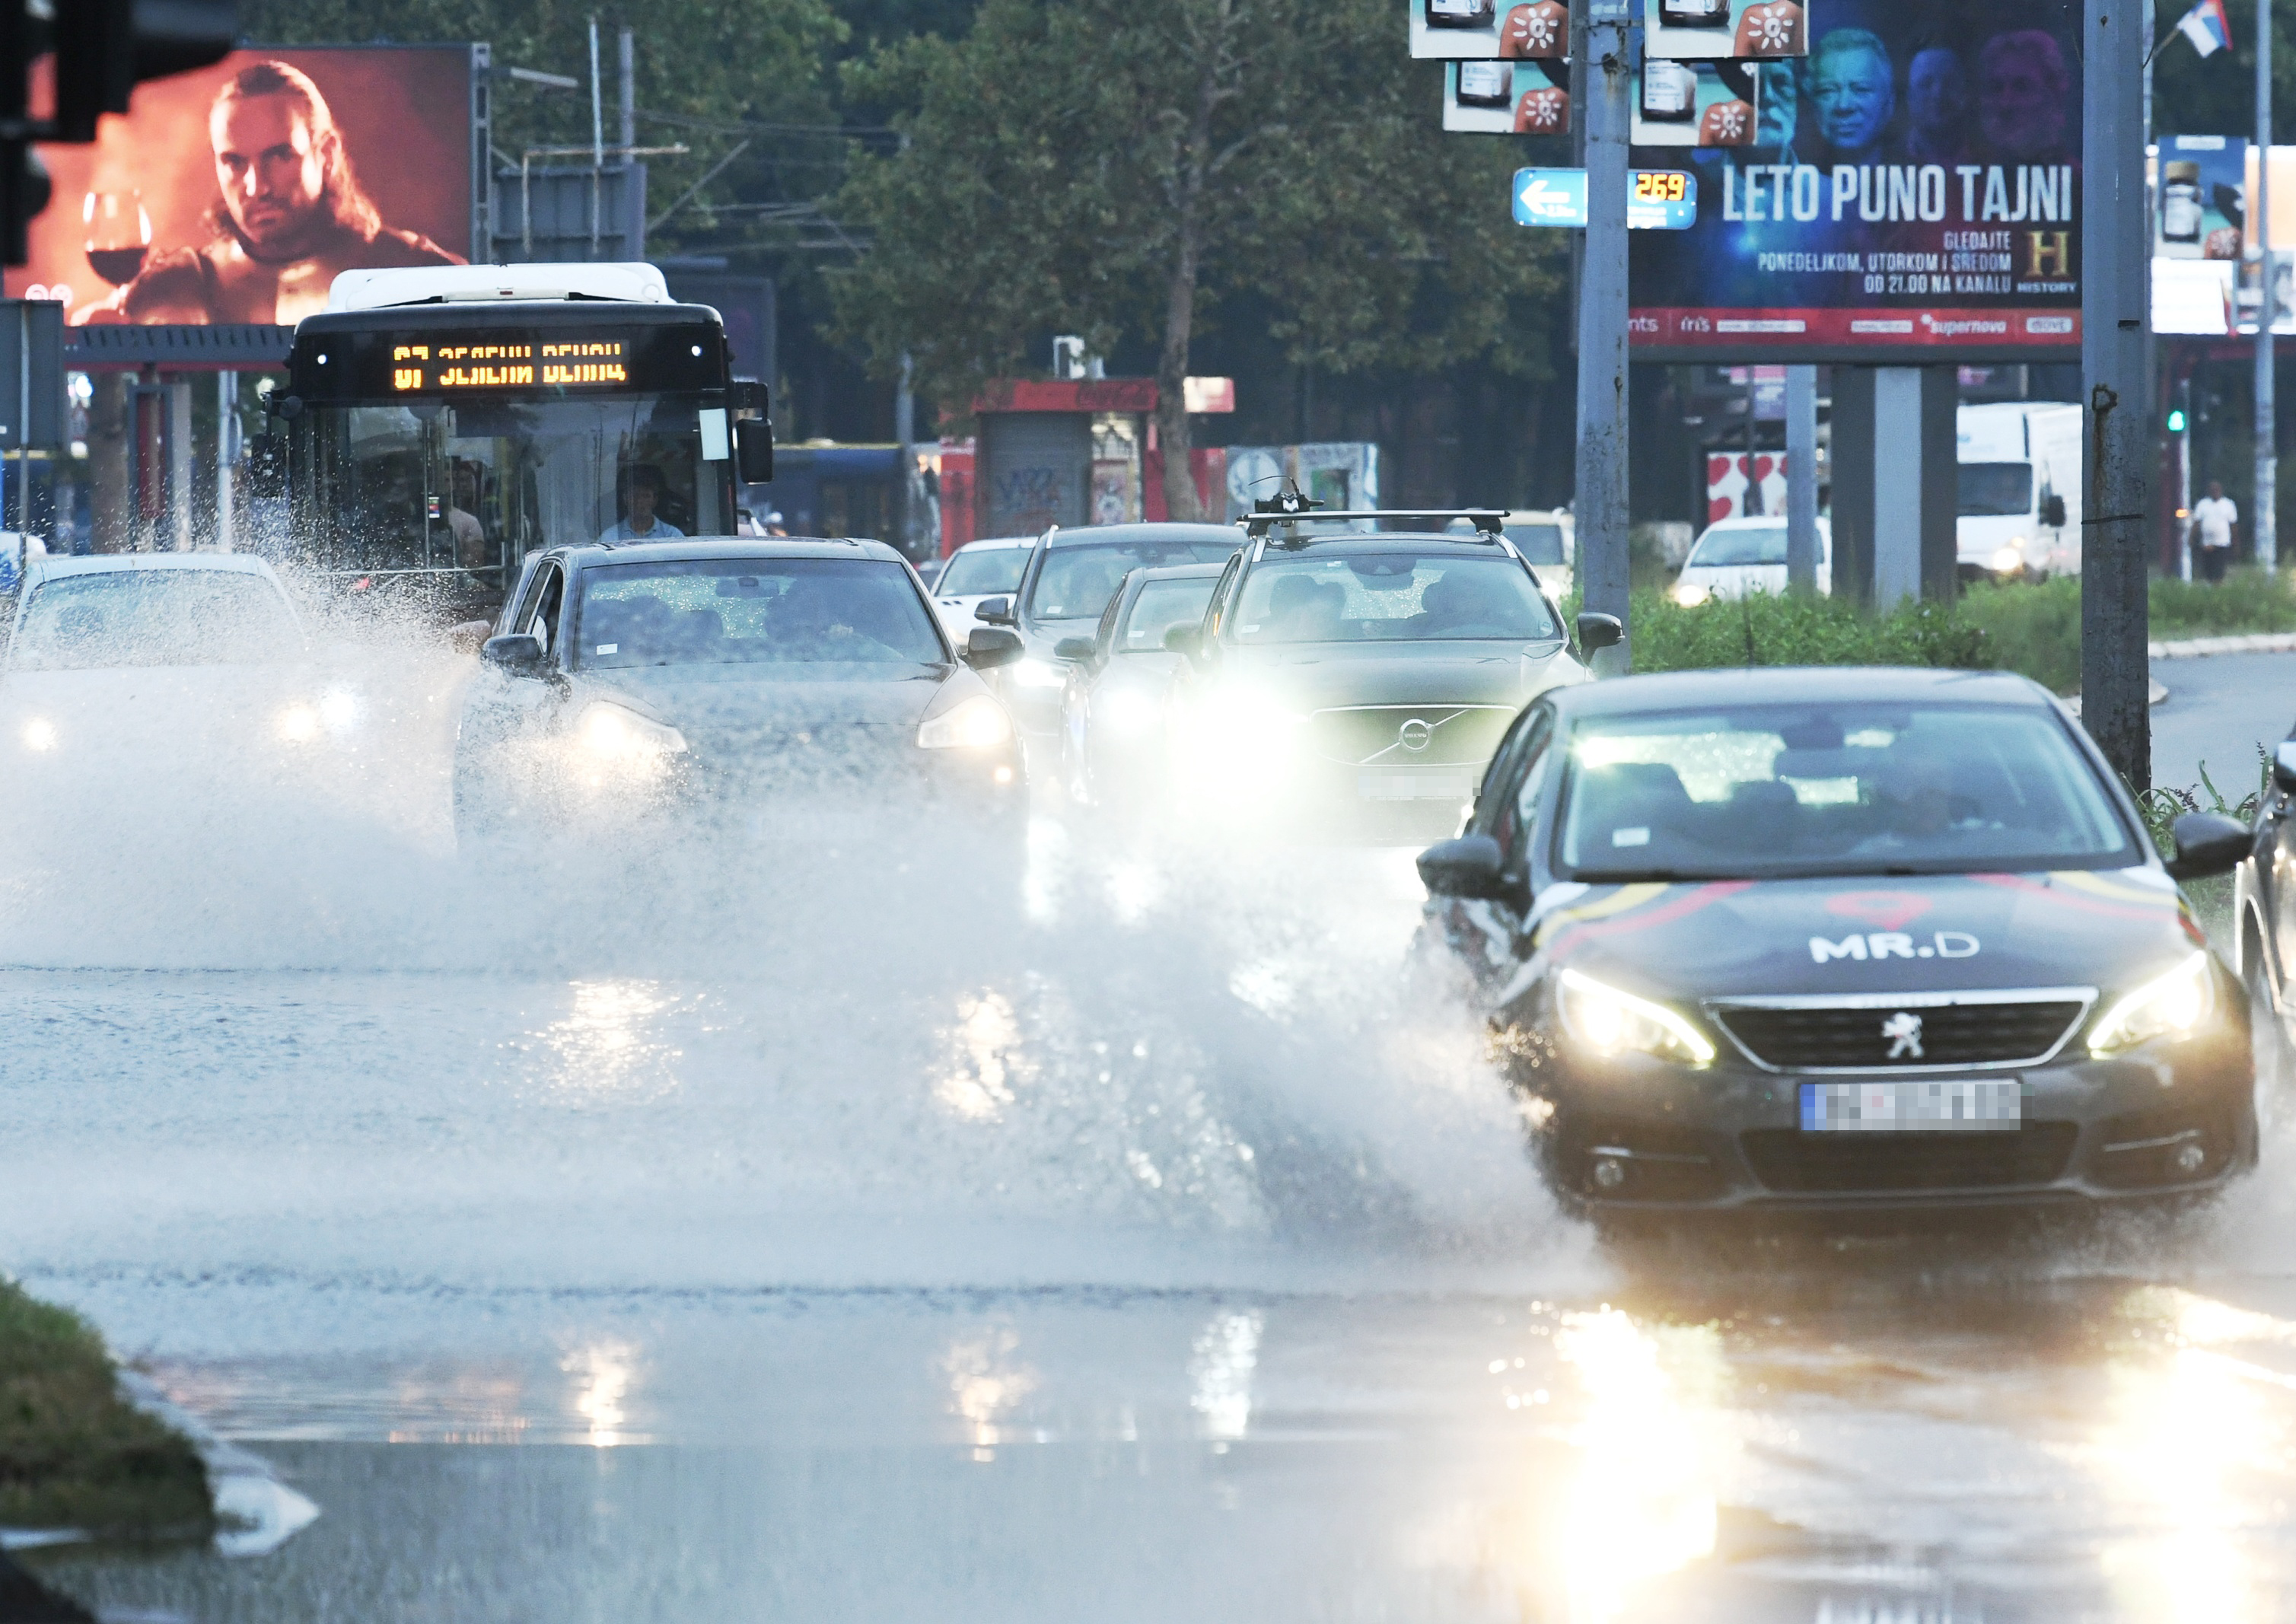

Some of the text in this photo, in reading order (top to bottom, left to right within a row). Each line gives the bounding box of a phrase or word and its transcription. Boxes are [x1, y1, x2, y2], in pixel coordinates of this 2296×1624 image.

[1635, 174, 1685, 201] 269
[1723, 164, 2072, 221] LETO PUNO TAJNI
[1944, 230, 2011, 250] GLEDAJTE
[1758, 253, 1865, 274] PONEDELJKOM,
[1868, 253, 1938, 272] UTORKOM
[1951, 253, 2011, 272] SREDOM
[1865, 275, 1885, 295] OD
[1931, 274, 1952, 294] NA
[1955, 274, 2011, 294] KANALU
[1809, 931, 1980, 963] MR.D
